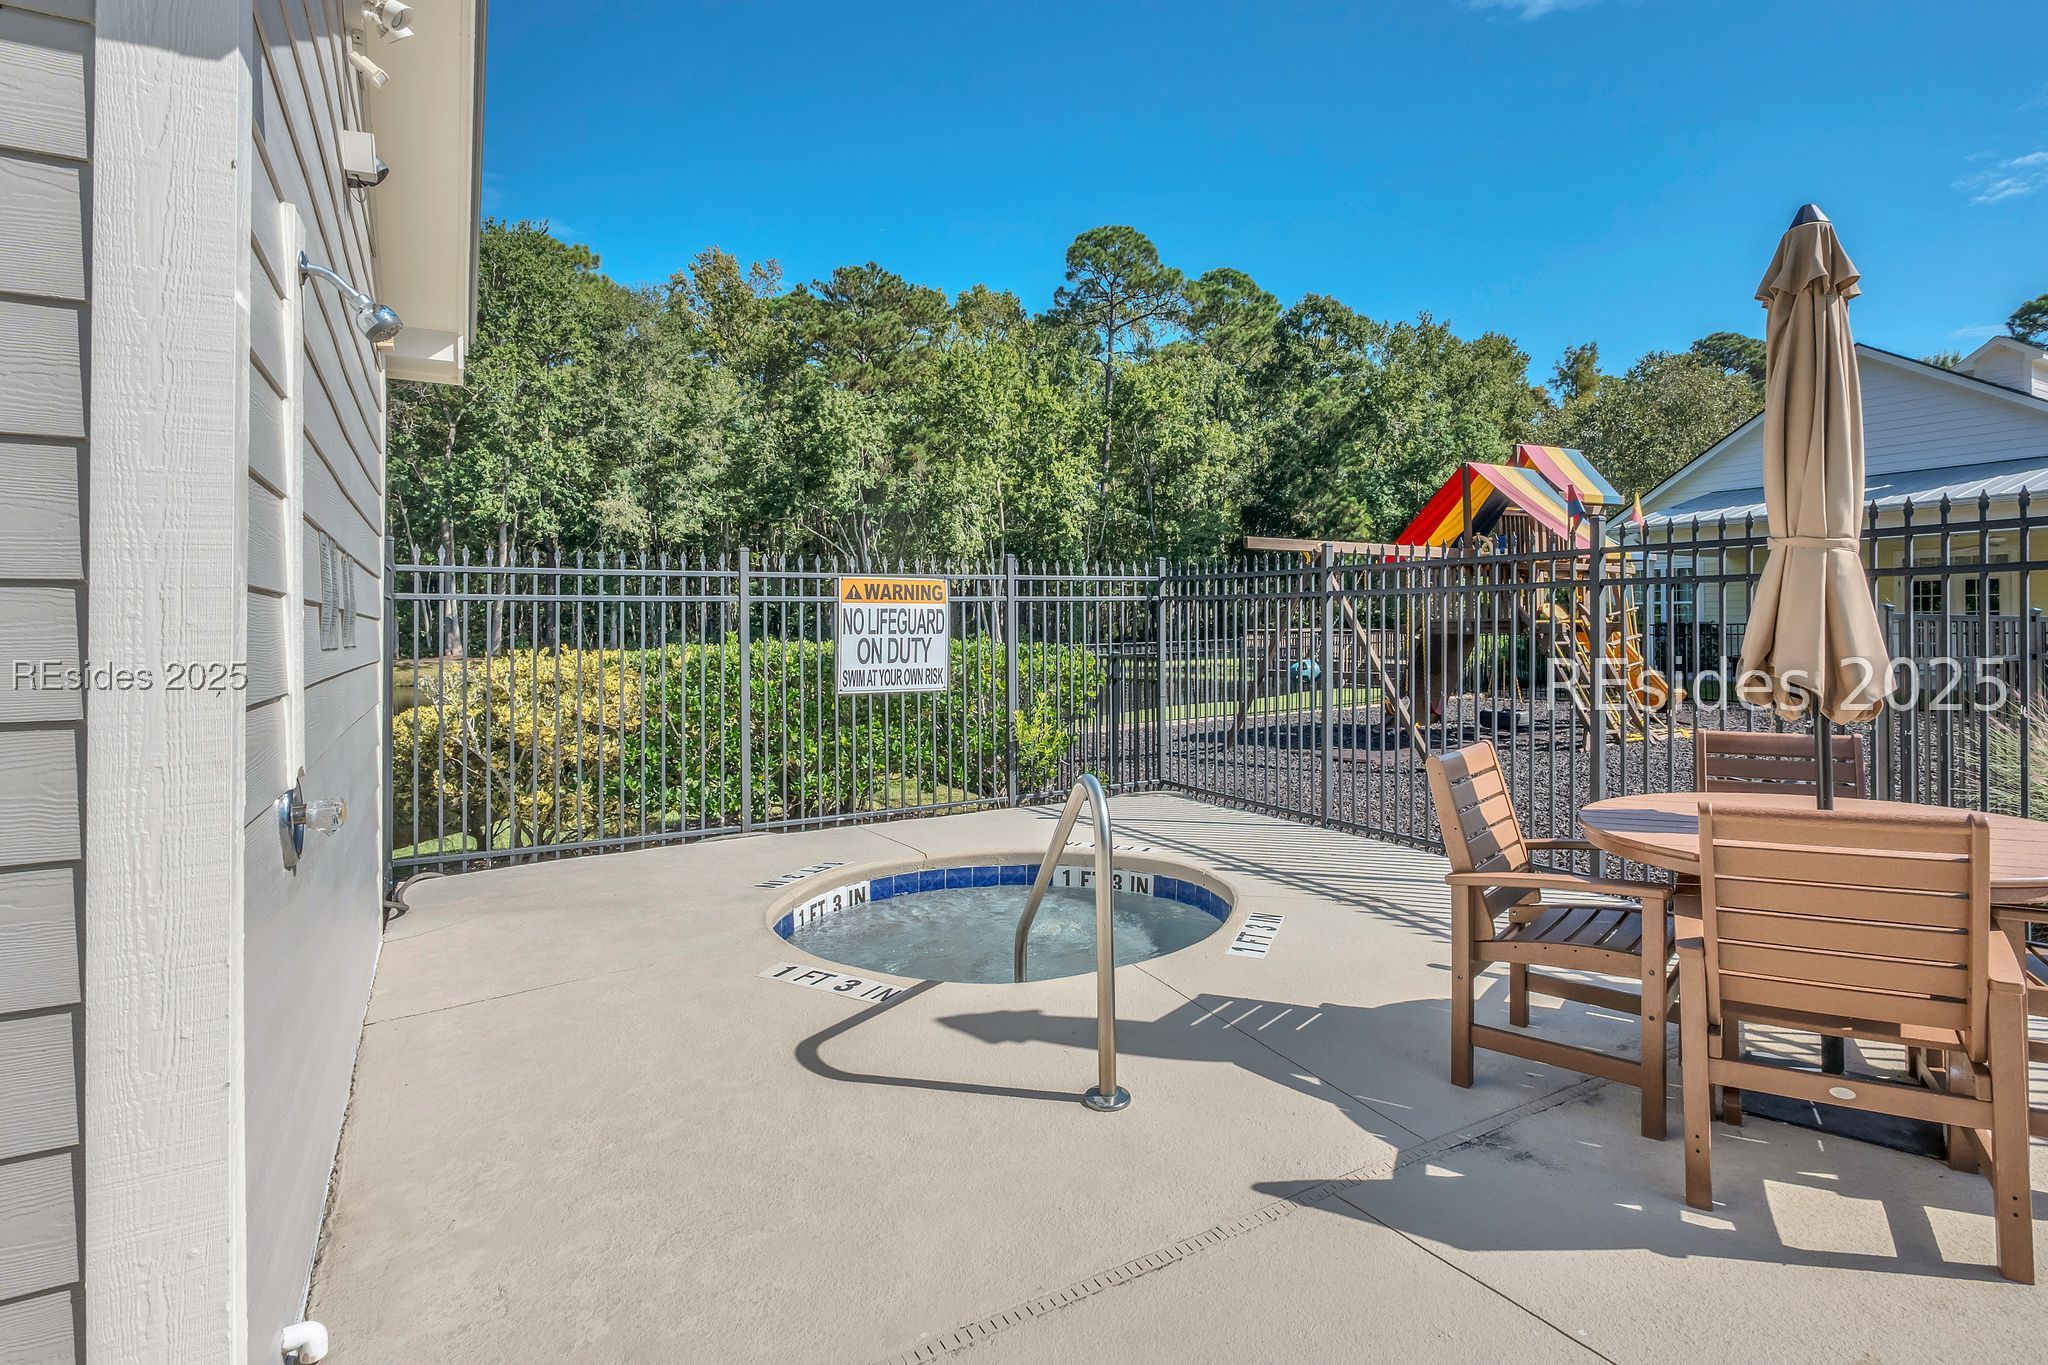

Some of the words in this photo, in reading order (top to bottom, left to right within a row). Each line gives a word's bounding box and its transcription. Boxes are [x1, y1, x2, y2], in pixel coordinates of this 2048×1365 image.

[864, 583, 944, 601] WARNING
[843, 608, 865, 635] NO
[868, 608, 945, 635] LIFEGUARD
[857, 637, 882, 665] ON
[887, 637, 933, 664] DUTY
[842, 669, 866, 688] SWIM
[866, 669, 878, 687] AT
[879, 668, 903, 686] YOUR
[903, 668, 924, 685] OWN
[925, 667, 944, 685] RISK
[1063, 870, 1071, 886] 1
[1081, 870, 1096, 886] F
[1113, 874, 1123, 890] 3
[1130, 875, 1149, 894] IN
[799, 909, 804, 927] 1
[810, 899, 826, 921] FT
[833, 894, 842, 912] 3
[848, 885, 866, 907] IN
[1248, 912, 1284, 924] IN
[1235, 931, 1273, 946] FT
[772, 966, 798, 977] 1
[793, 970, 838, 986] FT
[833, 979, 863, 992] 3
[860, 985, 903, 1002] IN
